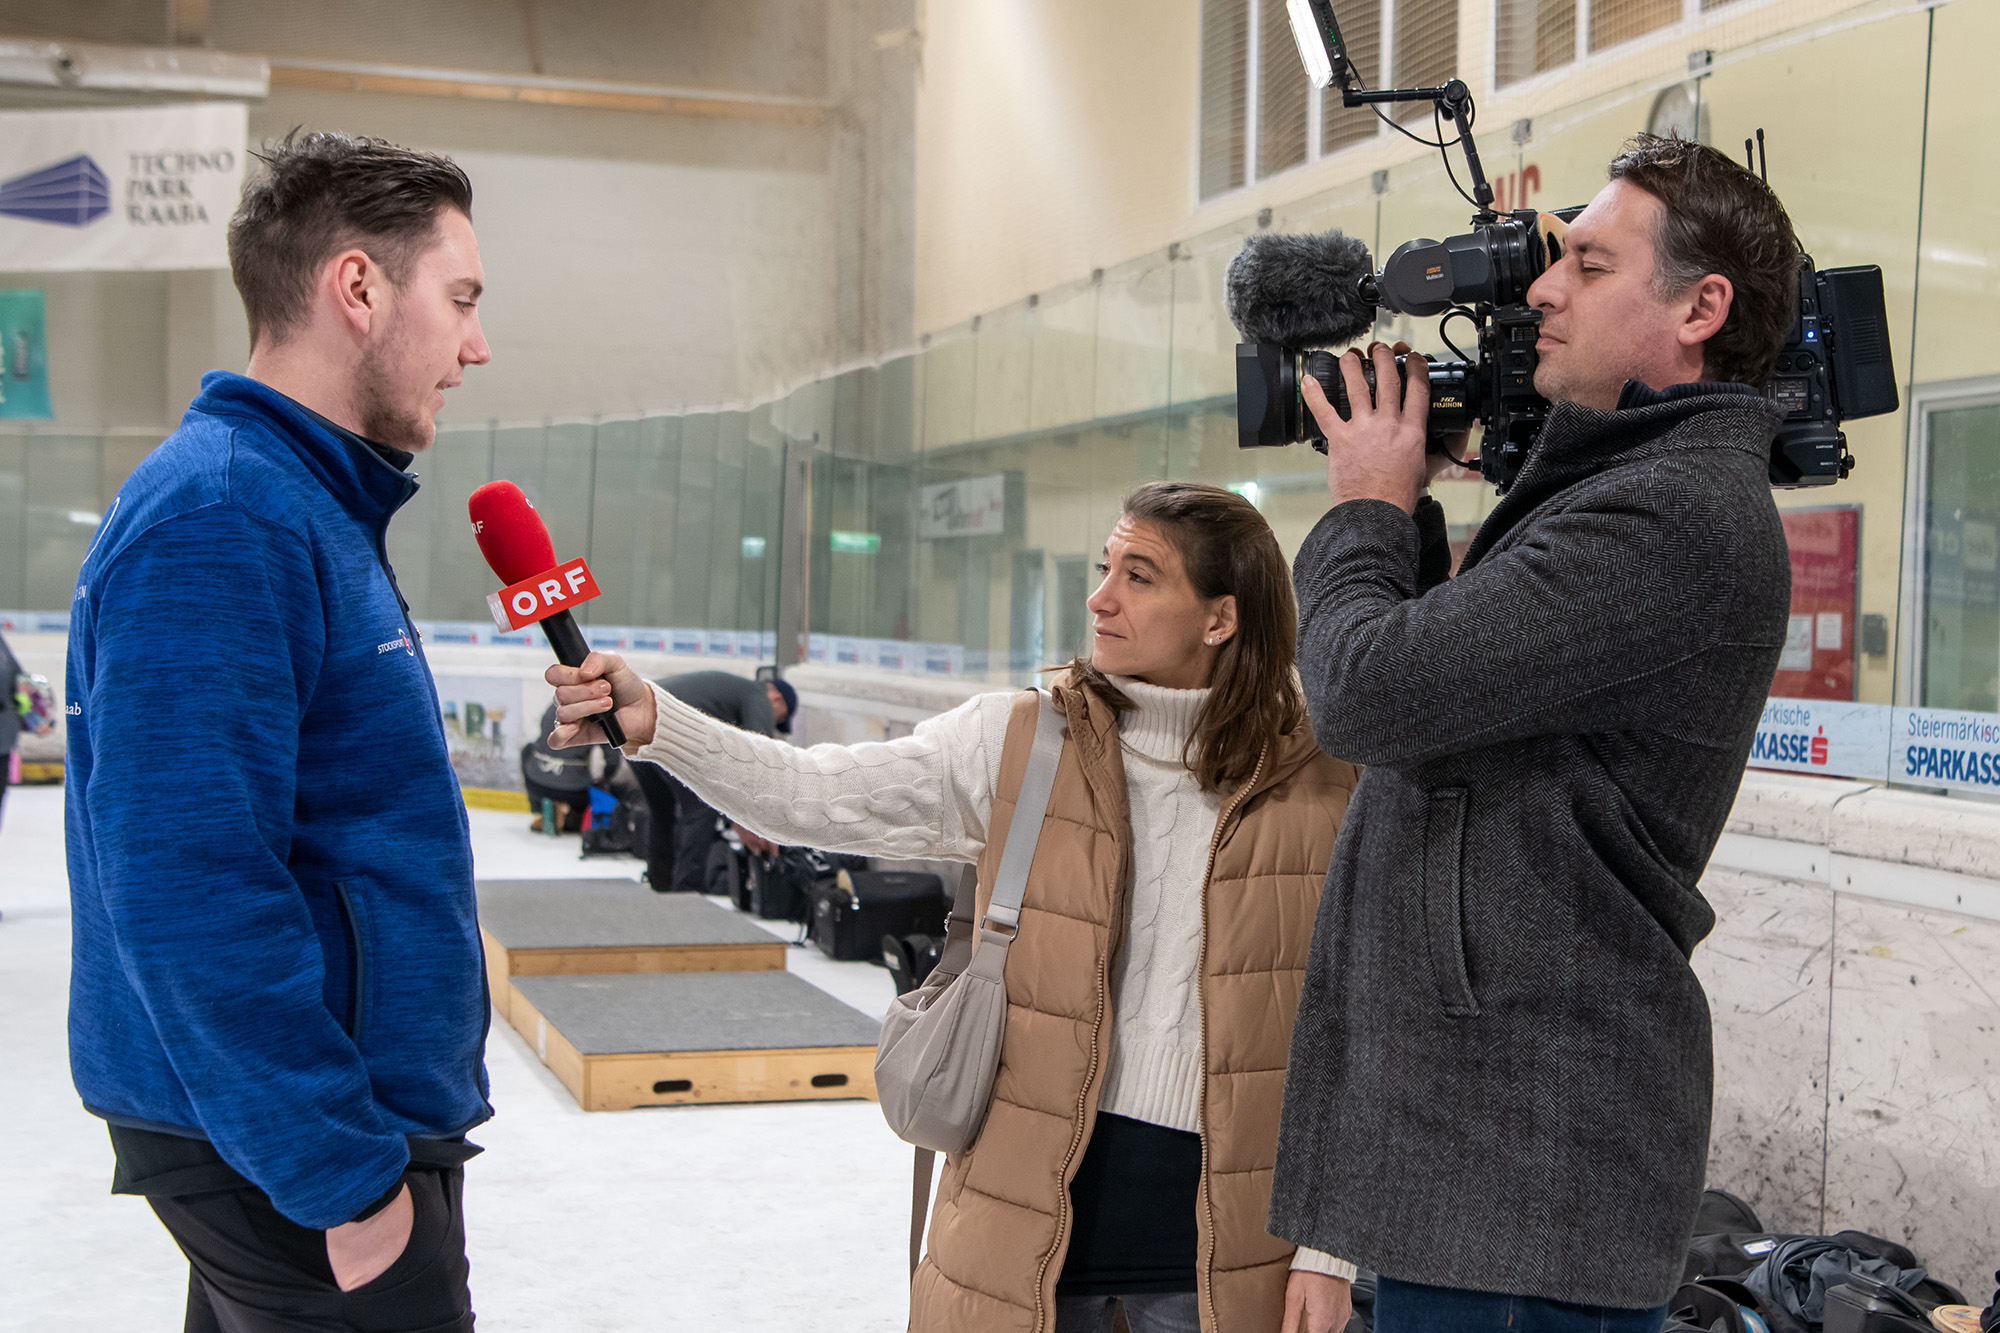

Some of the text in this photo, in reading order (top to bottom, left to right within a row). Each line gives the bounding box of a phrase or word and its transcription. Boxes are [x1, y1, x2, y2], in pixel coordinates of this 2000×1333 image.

[129, 149, 235, 174] TECHNO
[127, 178, 193, 199] PARK
[126, 203, 210, 225] RAABA
[512, 566, 586, 616] ORF
